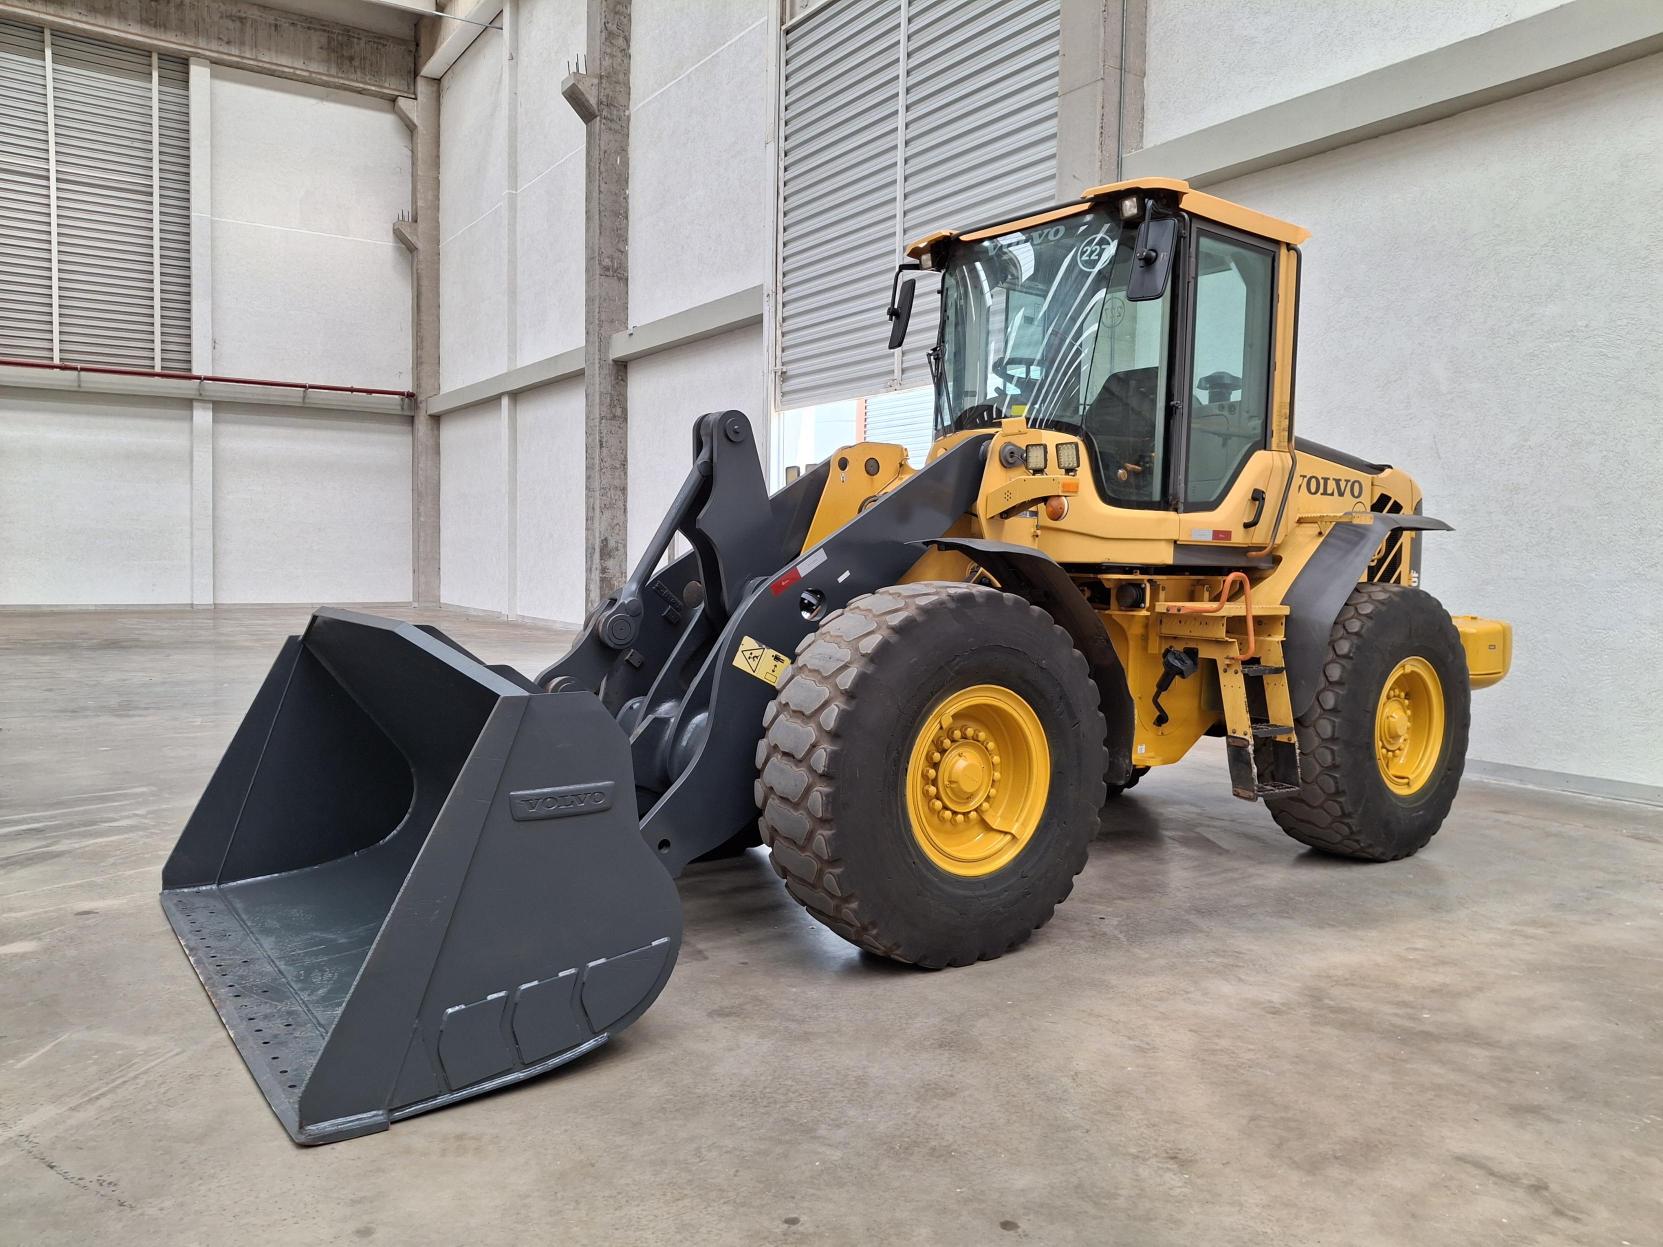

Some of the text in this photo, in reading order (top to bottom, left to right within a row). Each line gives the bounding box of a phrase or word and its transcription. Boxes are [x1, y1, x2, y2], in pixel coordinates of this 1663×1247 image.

[987, 225, 1066, 256] VVO
[1081, 244, 1111, 260] 227
[520, 791, 605, 812] VOLVO
